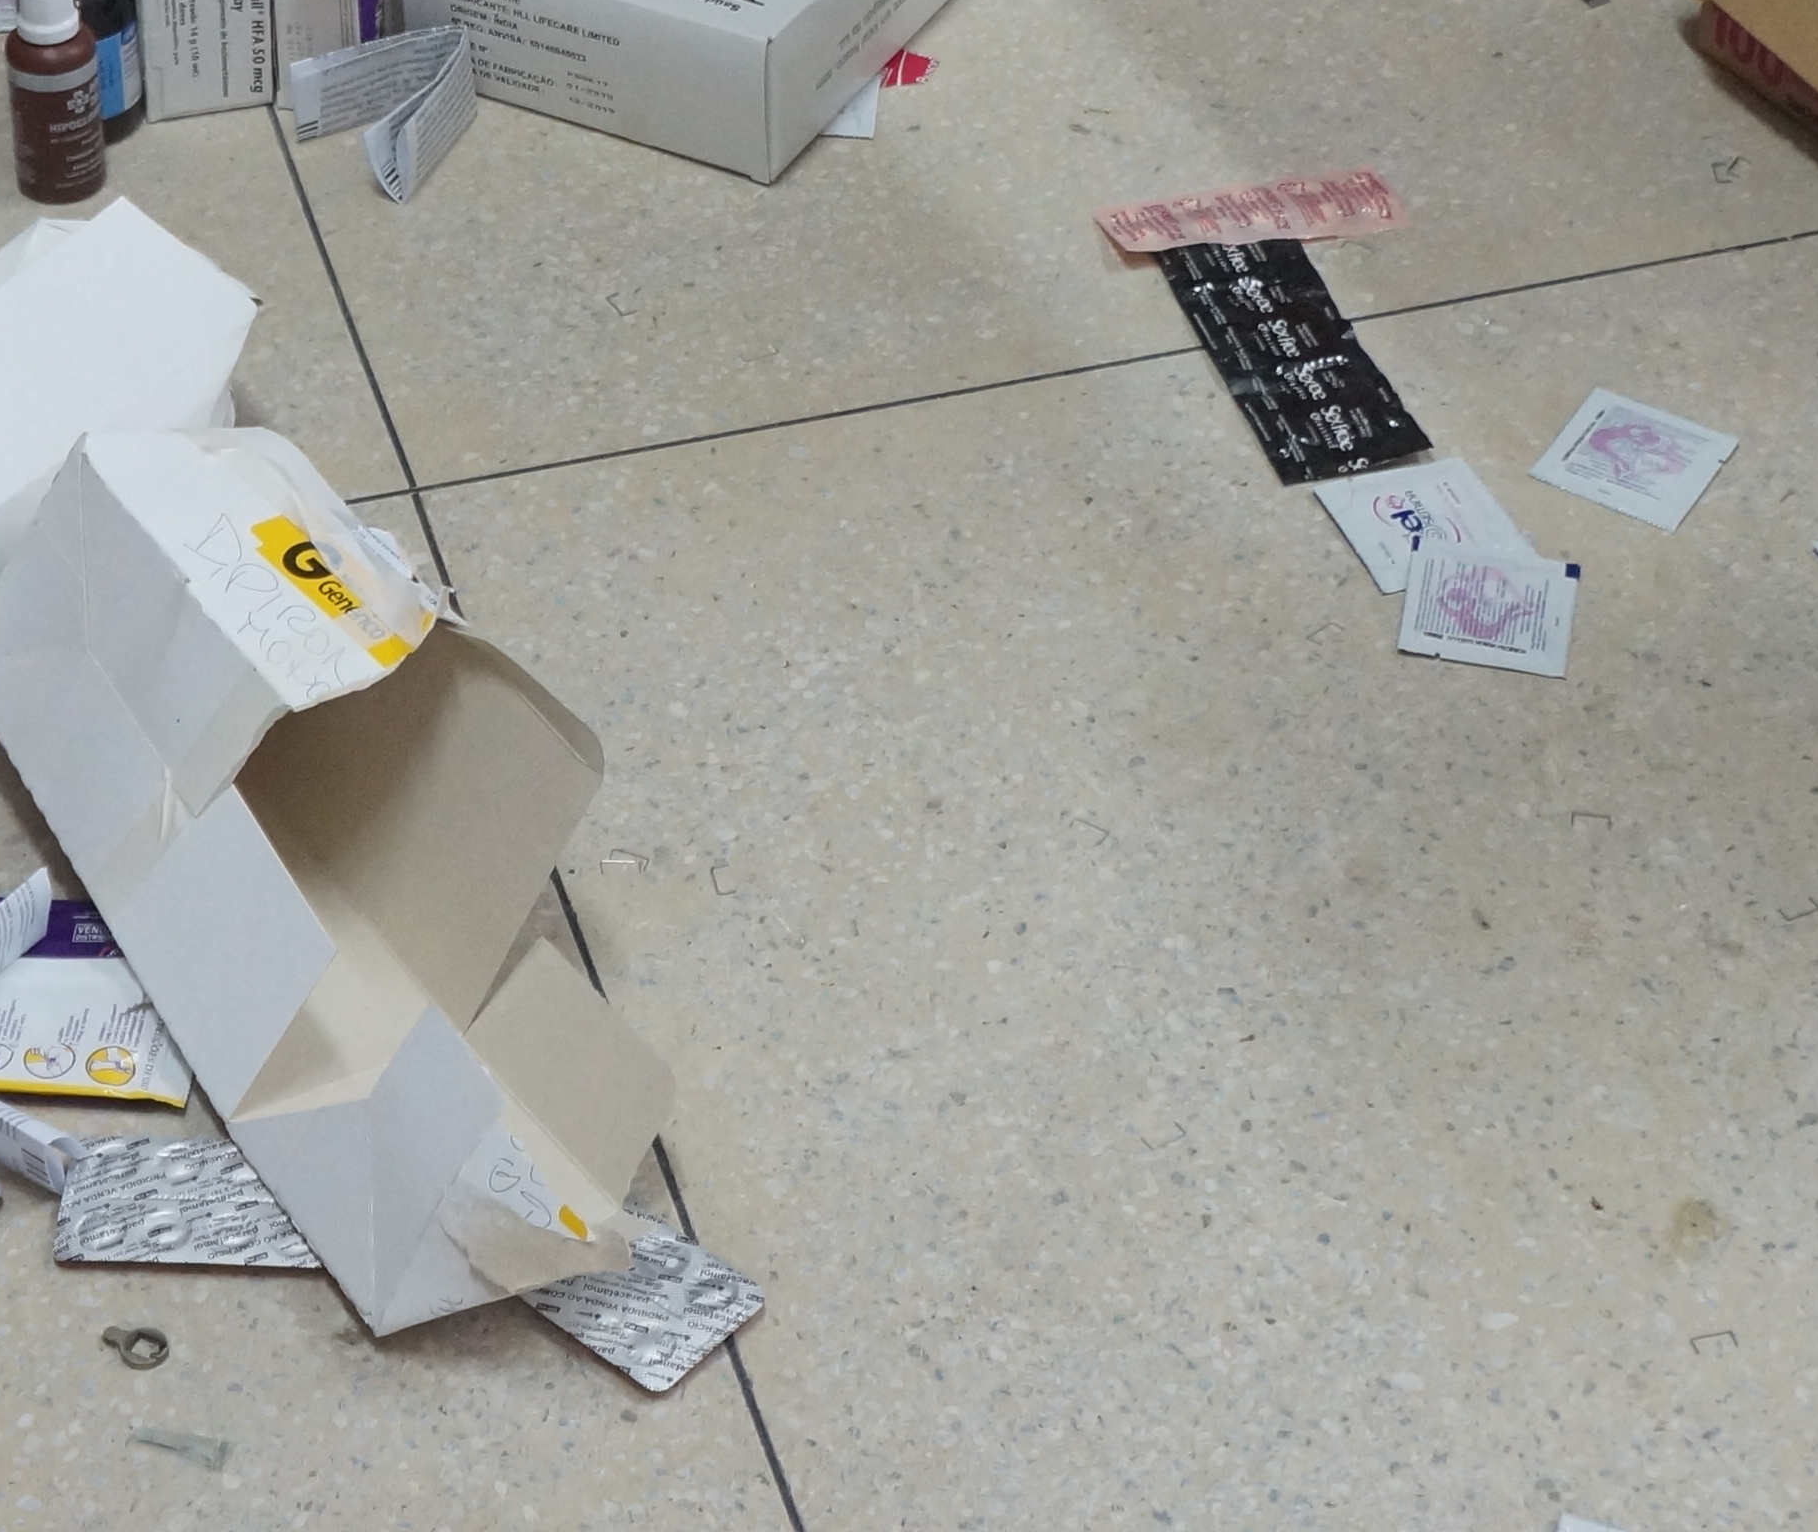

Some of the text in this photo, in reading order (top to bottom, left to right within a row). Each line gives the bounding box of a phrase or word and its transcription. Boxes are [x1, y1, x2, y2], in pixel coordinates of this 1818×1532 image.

[582, 29, 621, 47] LIMITED
[250, 21, 266, 93] HFA 50 mcg
[583, 1281, 651, 1304] paracetamol
